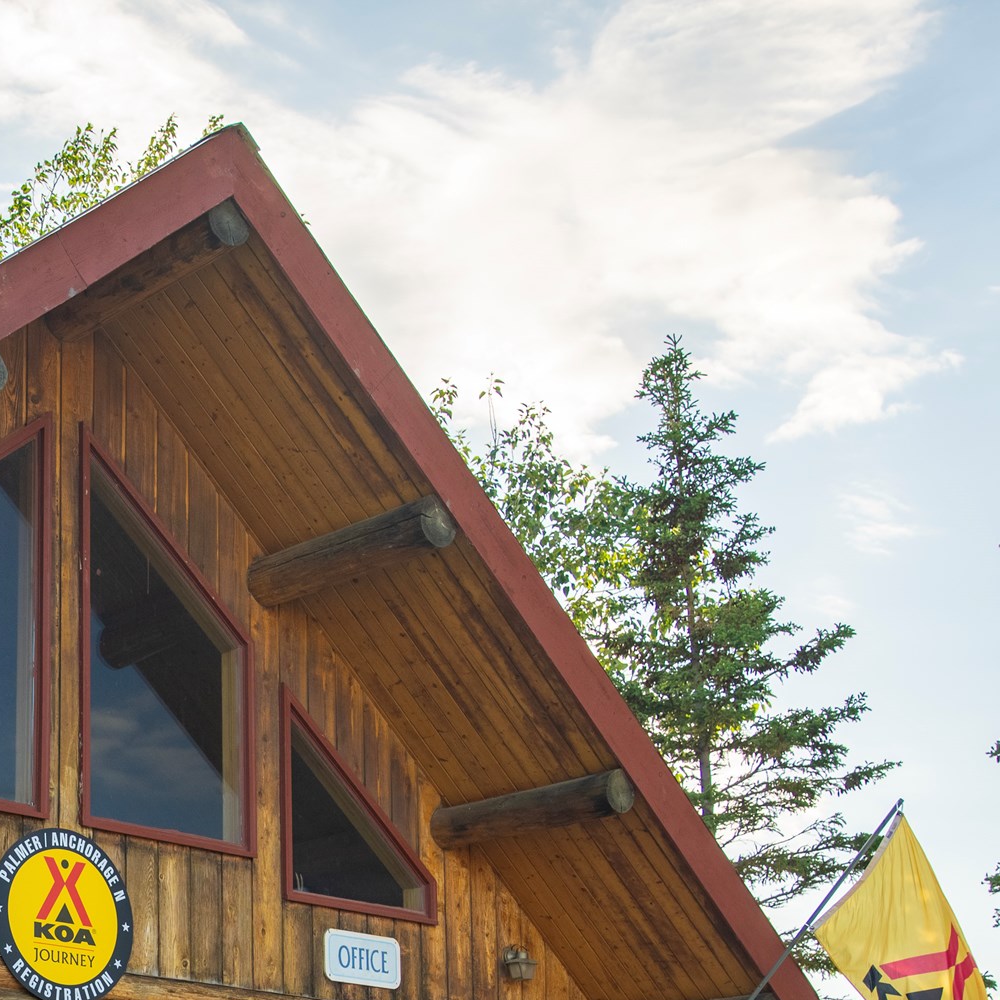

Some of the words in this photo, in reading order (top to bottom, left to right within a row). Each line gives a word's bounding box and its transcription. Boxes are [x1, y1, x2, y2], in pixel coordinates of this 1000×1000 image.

[33, 921, 97, 947] KOA
[33, 947, 96, 968] JOURNEY
[338, 945, 389, 975] OFFICE
